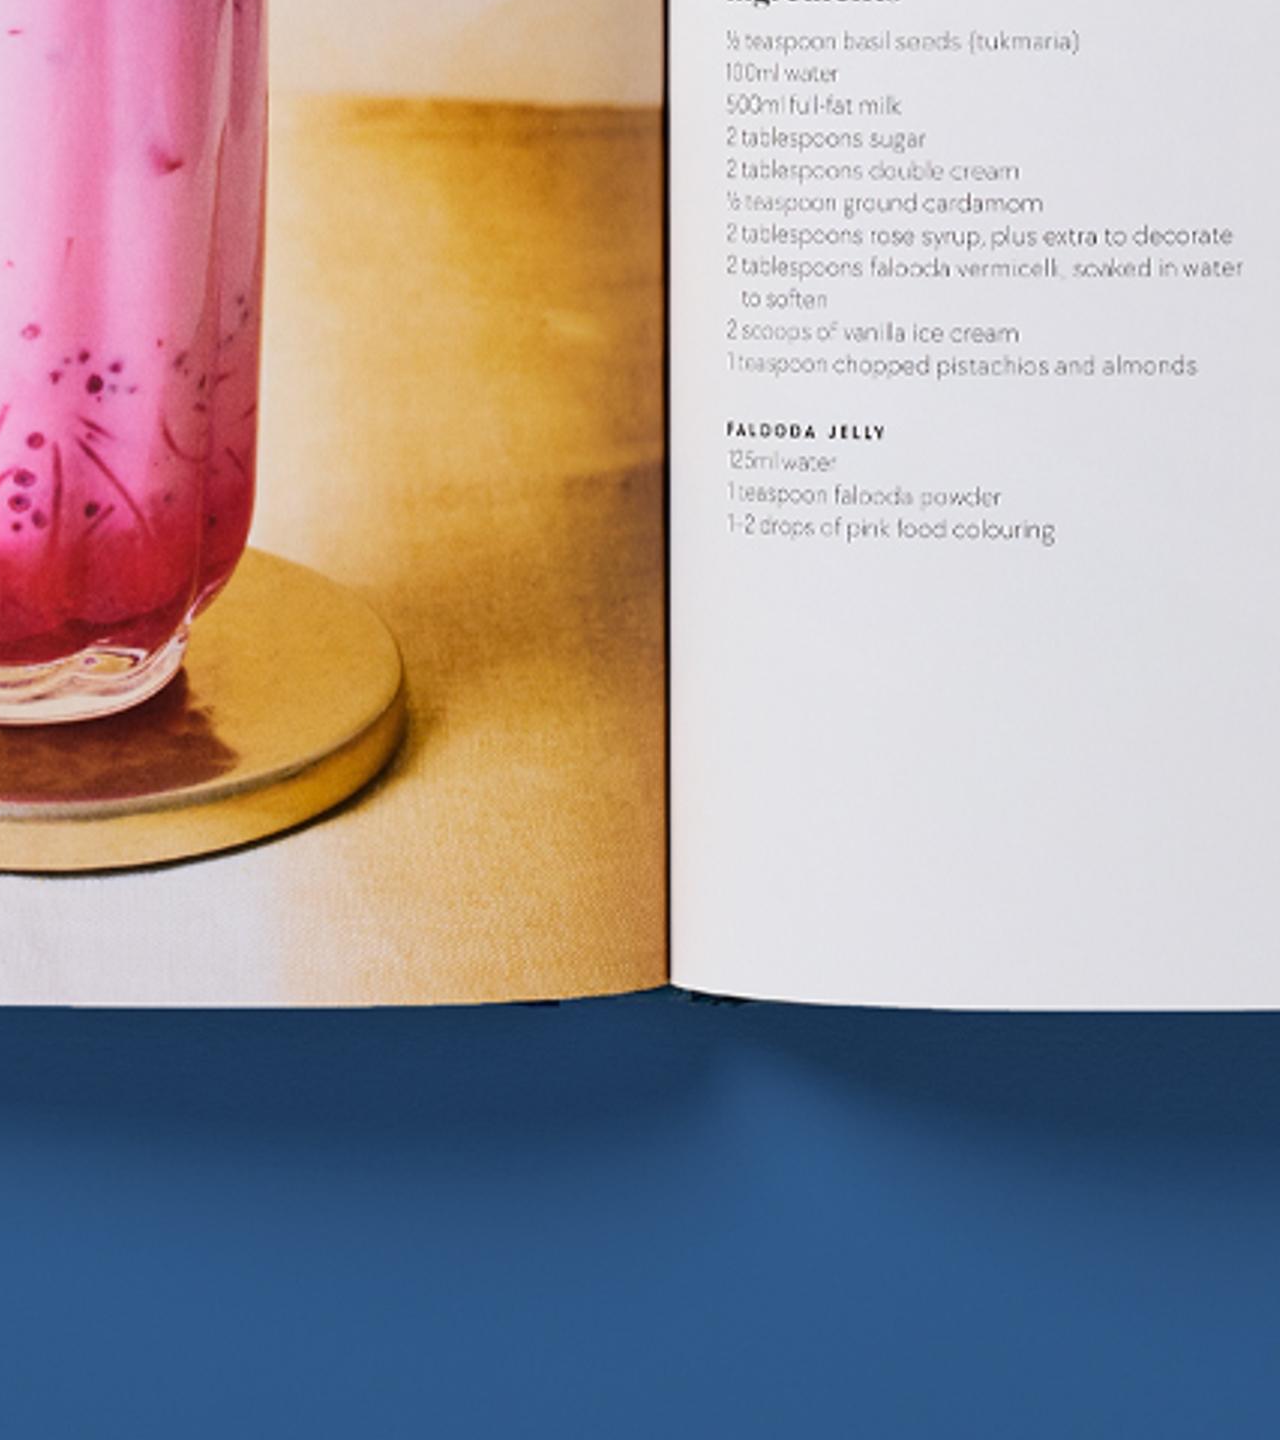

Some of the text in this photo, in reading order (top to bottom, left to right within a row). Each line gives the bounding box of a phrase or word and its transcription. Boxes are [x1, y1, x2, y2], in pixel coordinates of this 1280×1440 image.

[726, 60, 839, 84] 100ml water
[726, 125, 926, 155] 2 tablespoons sugar
[727, 218, 1234, 253] 2 tablespoons rose syrup, plus extra to decorate
[728, 351, 1199, 382] 1 teaspoon chopped pistachios and almonds
[726, 419, 885, 442] FALOODA JELLY
[760, 514, 815, 541] drops
[820, 515, 843, 538] of
[847, 517, 890, 545] pink
[897, 516, 947, 540] food
[952, 518, 1055, 548] colouring
